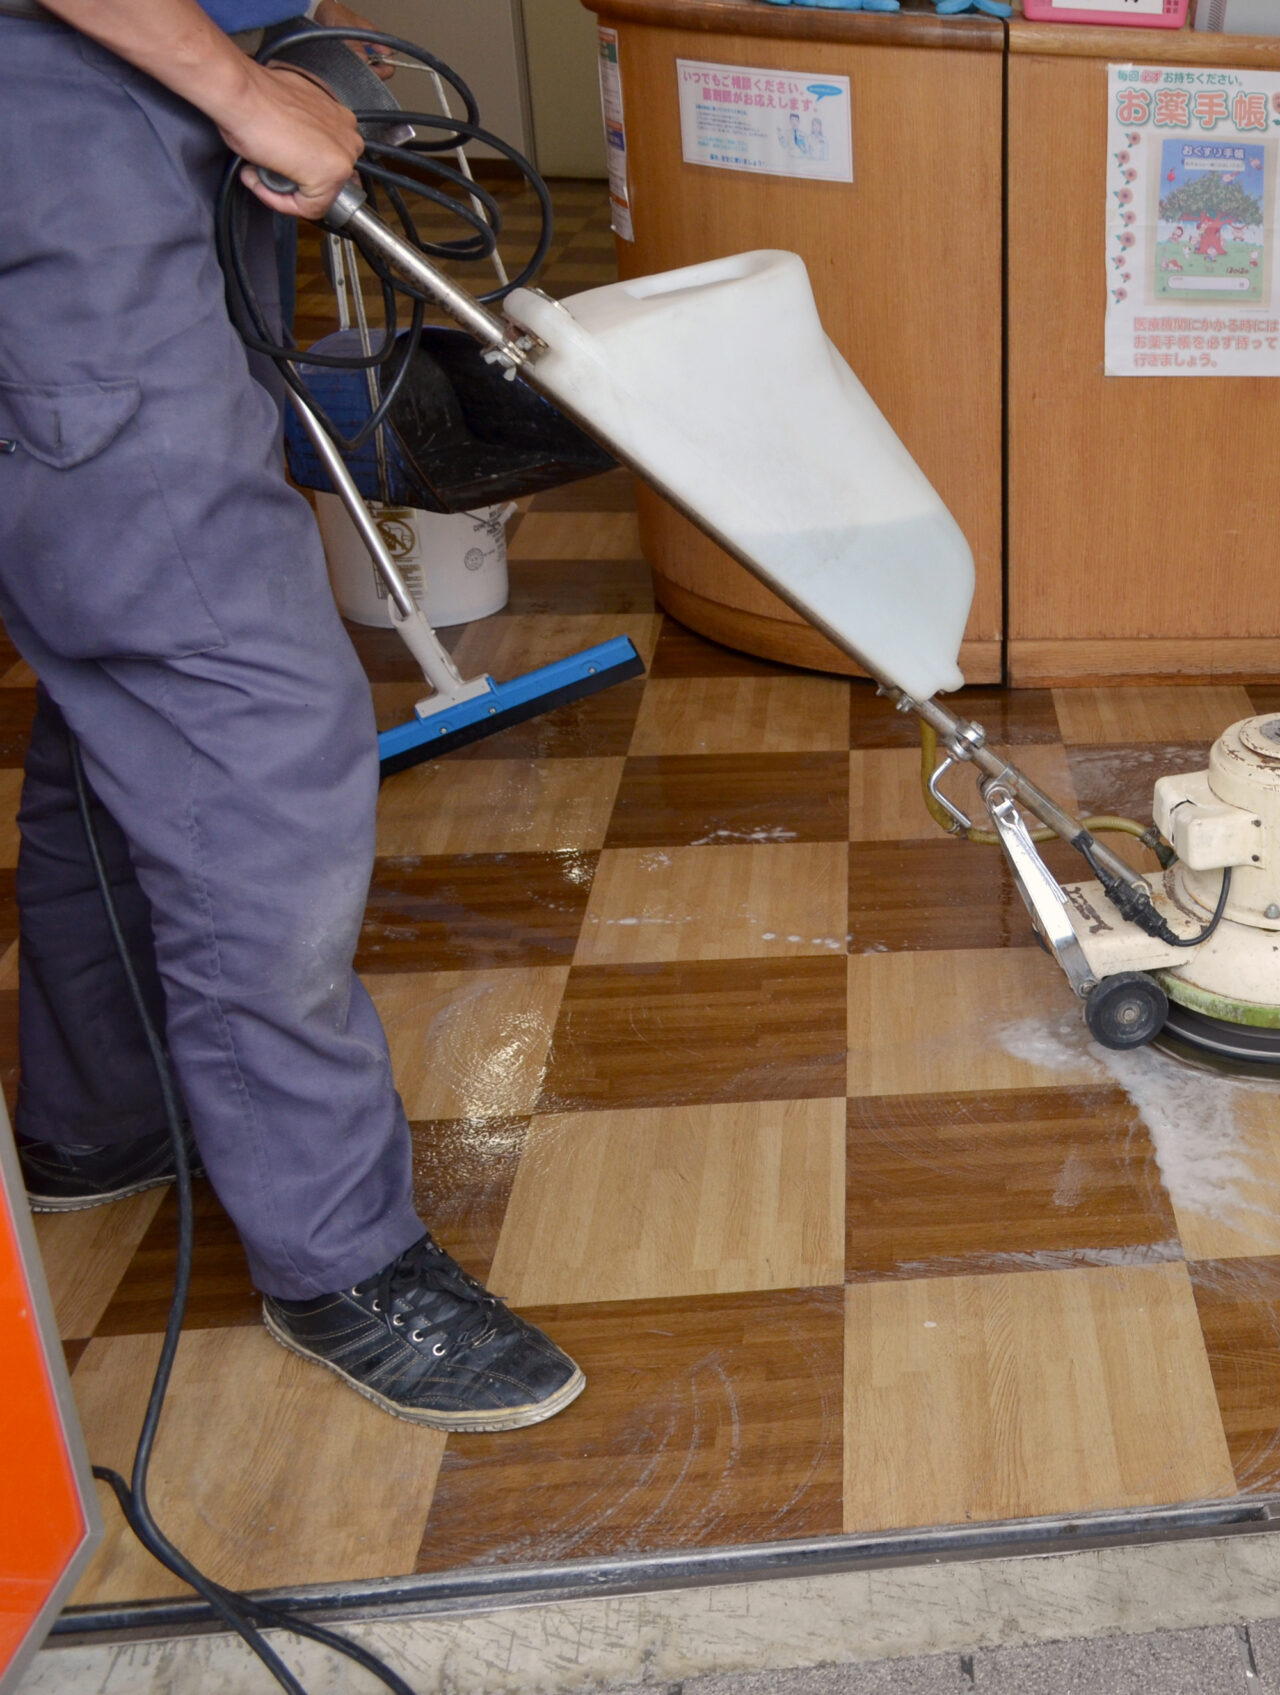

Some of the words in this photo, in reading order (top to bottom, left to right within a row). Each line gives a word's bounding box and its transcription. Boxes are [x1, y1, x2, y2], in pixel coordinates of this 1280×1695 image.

[683, 71, 804, 96] いつでもご相談ください。
[1116, 87, 1269, 132] お薬手帳
[1182, 145, 1246, 160] おくすり手帳
[1133, 334, 1278, 351] お薬手帳を必ず持って
[1133, 352, 1218, 368] 行きましょう。
